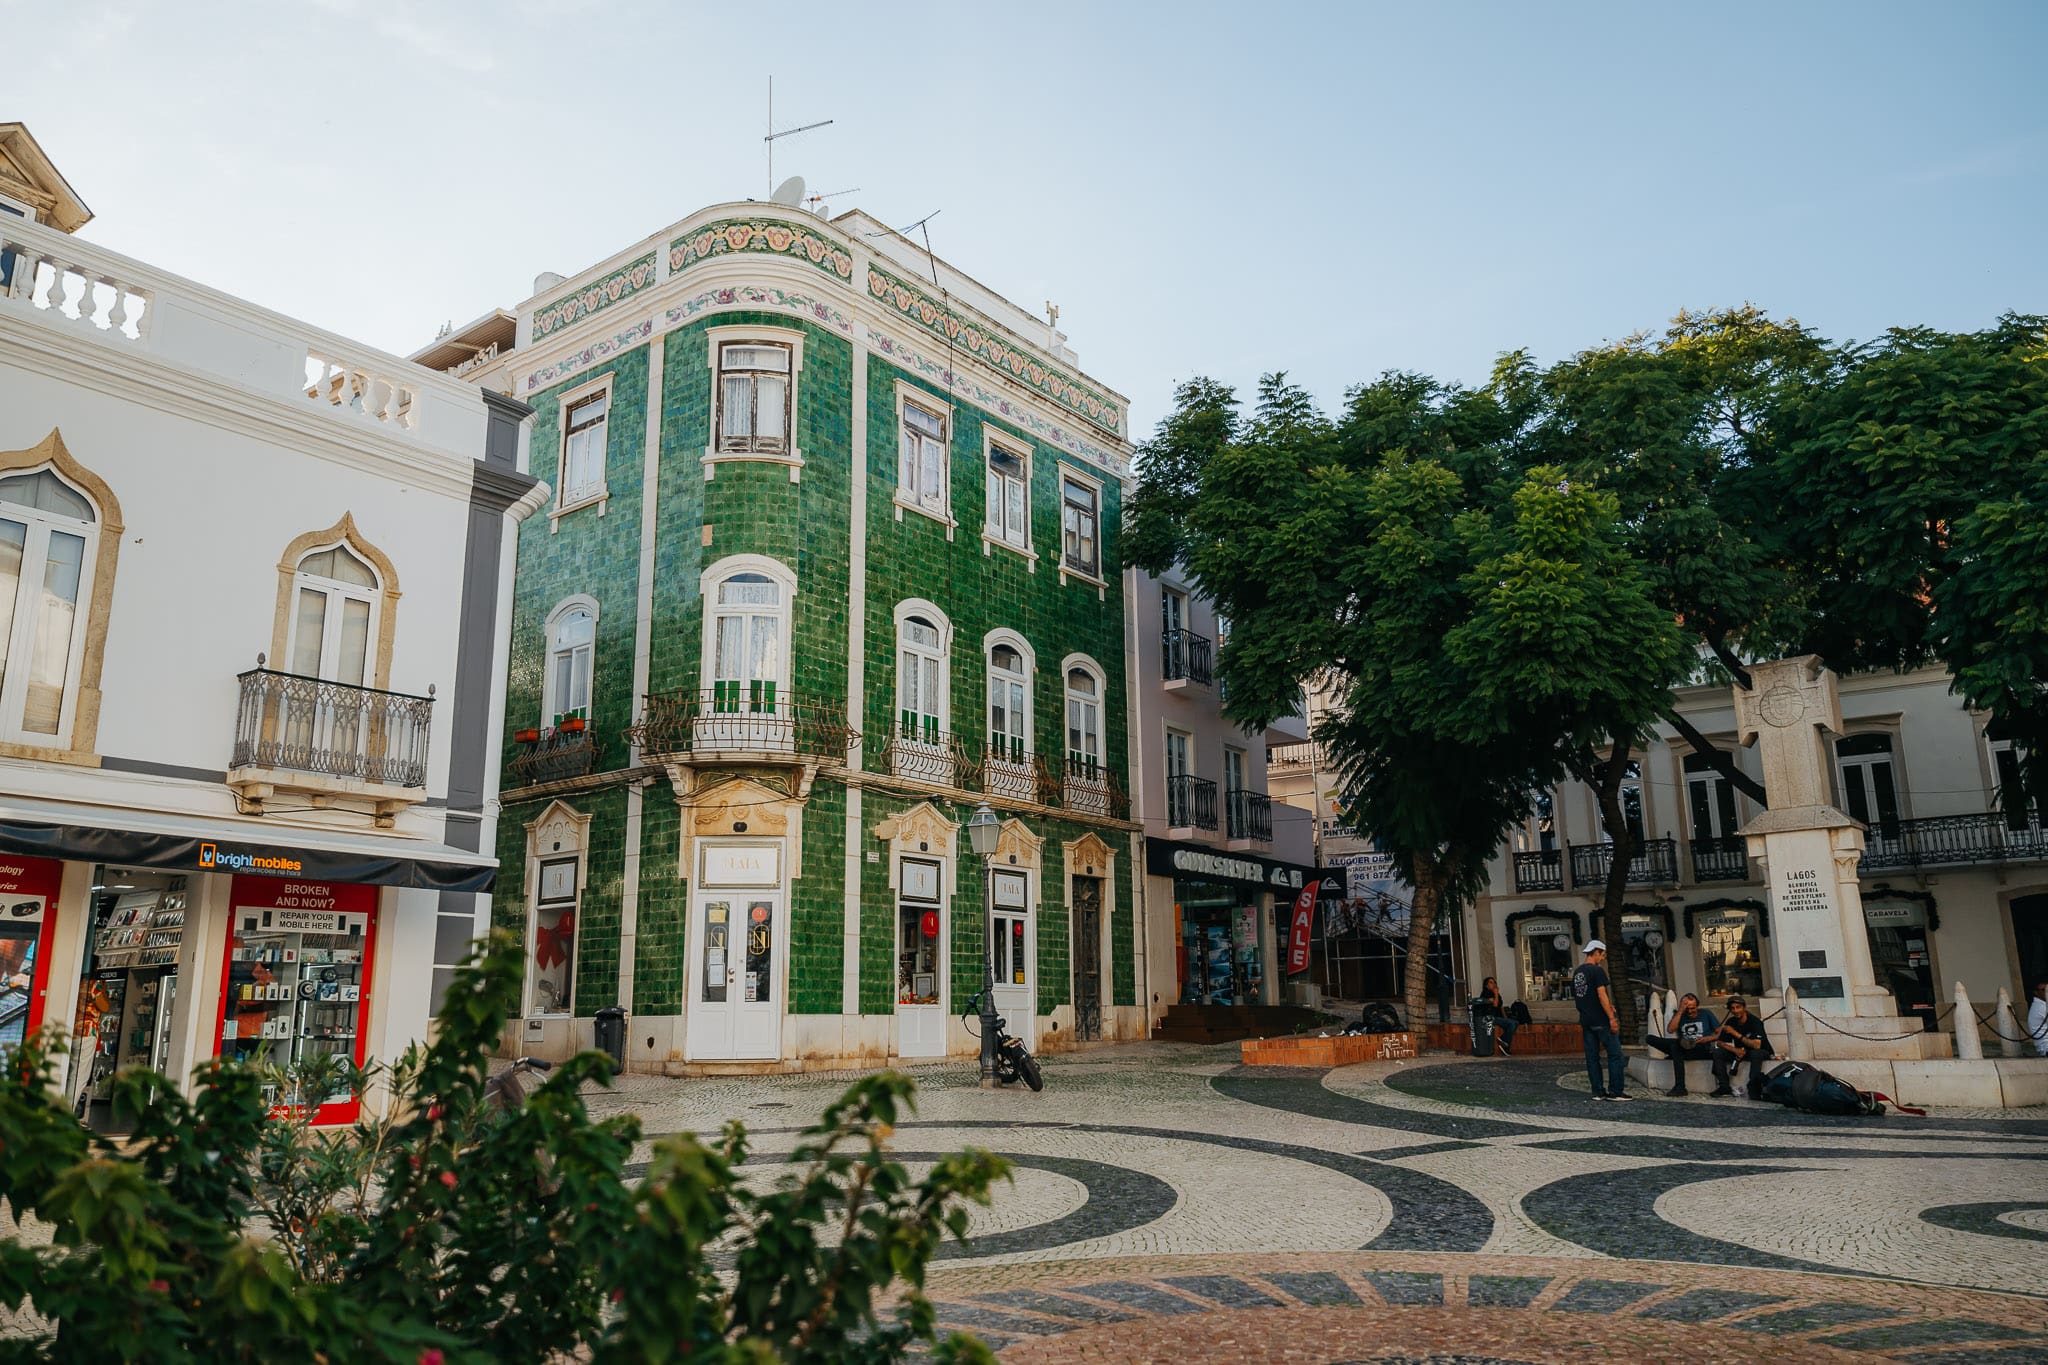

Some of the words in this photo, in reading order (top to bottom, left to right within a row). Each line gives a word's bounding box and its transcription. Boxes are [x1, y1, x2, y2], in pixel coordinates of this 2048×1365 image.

[1323, 828, 1357, 837] PINTUR
[216, 852, 302, 871] brightmobiles
[1173, 850, 1264, 883] QUIKSILVER
[0, 865, 24, 876] ology
[1347, 865, 1371, 873] NTAGEM
[1372, 871, 1390, 879] 872
[1787, 870, 1816, 880] LAGOS
[0, 882, 18, 890] ries
[284, 884, 330, 896] BROKEN
[275, 896, 299, 907] AND
[301, 897, 336, 909] NOW?
[280, 911, 310, 920] REPAIR
[311, 913, 334, 921] YOUR
[1868, 910, 1909, 918] CARAVELA
[279, 920, 310, 929] MOBILE
[311, 922, 334, 930] HERE
[1293, 892, 1312, 966] SALE
